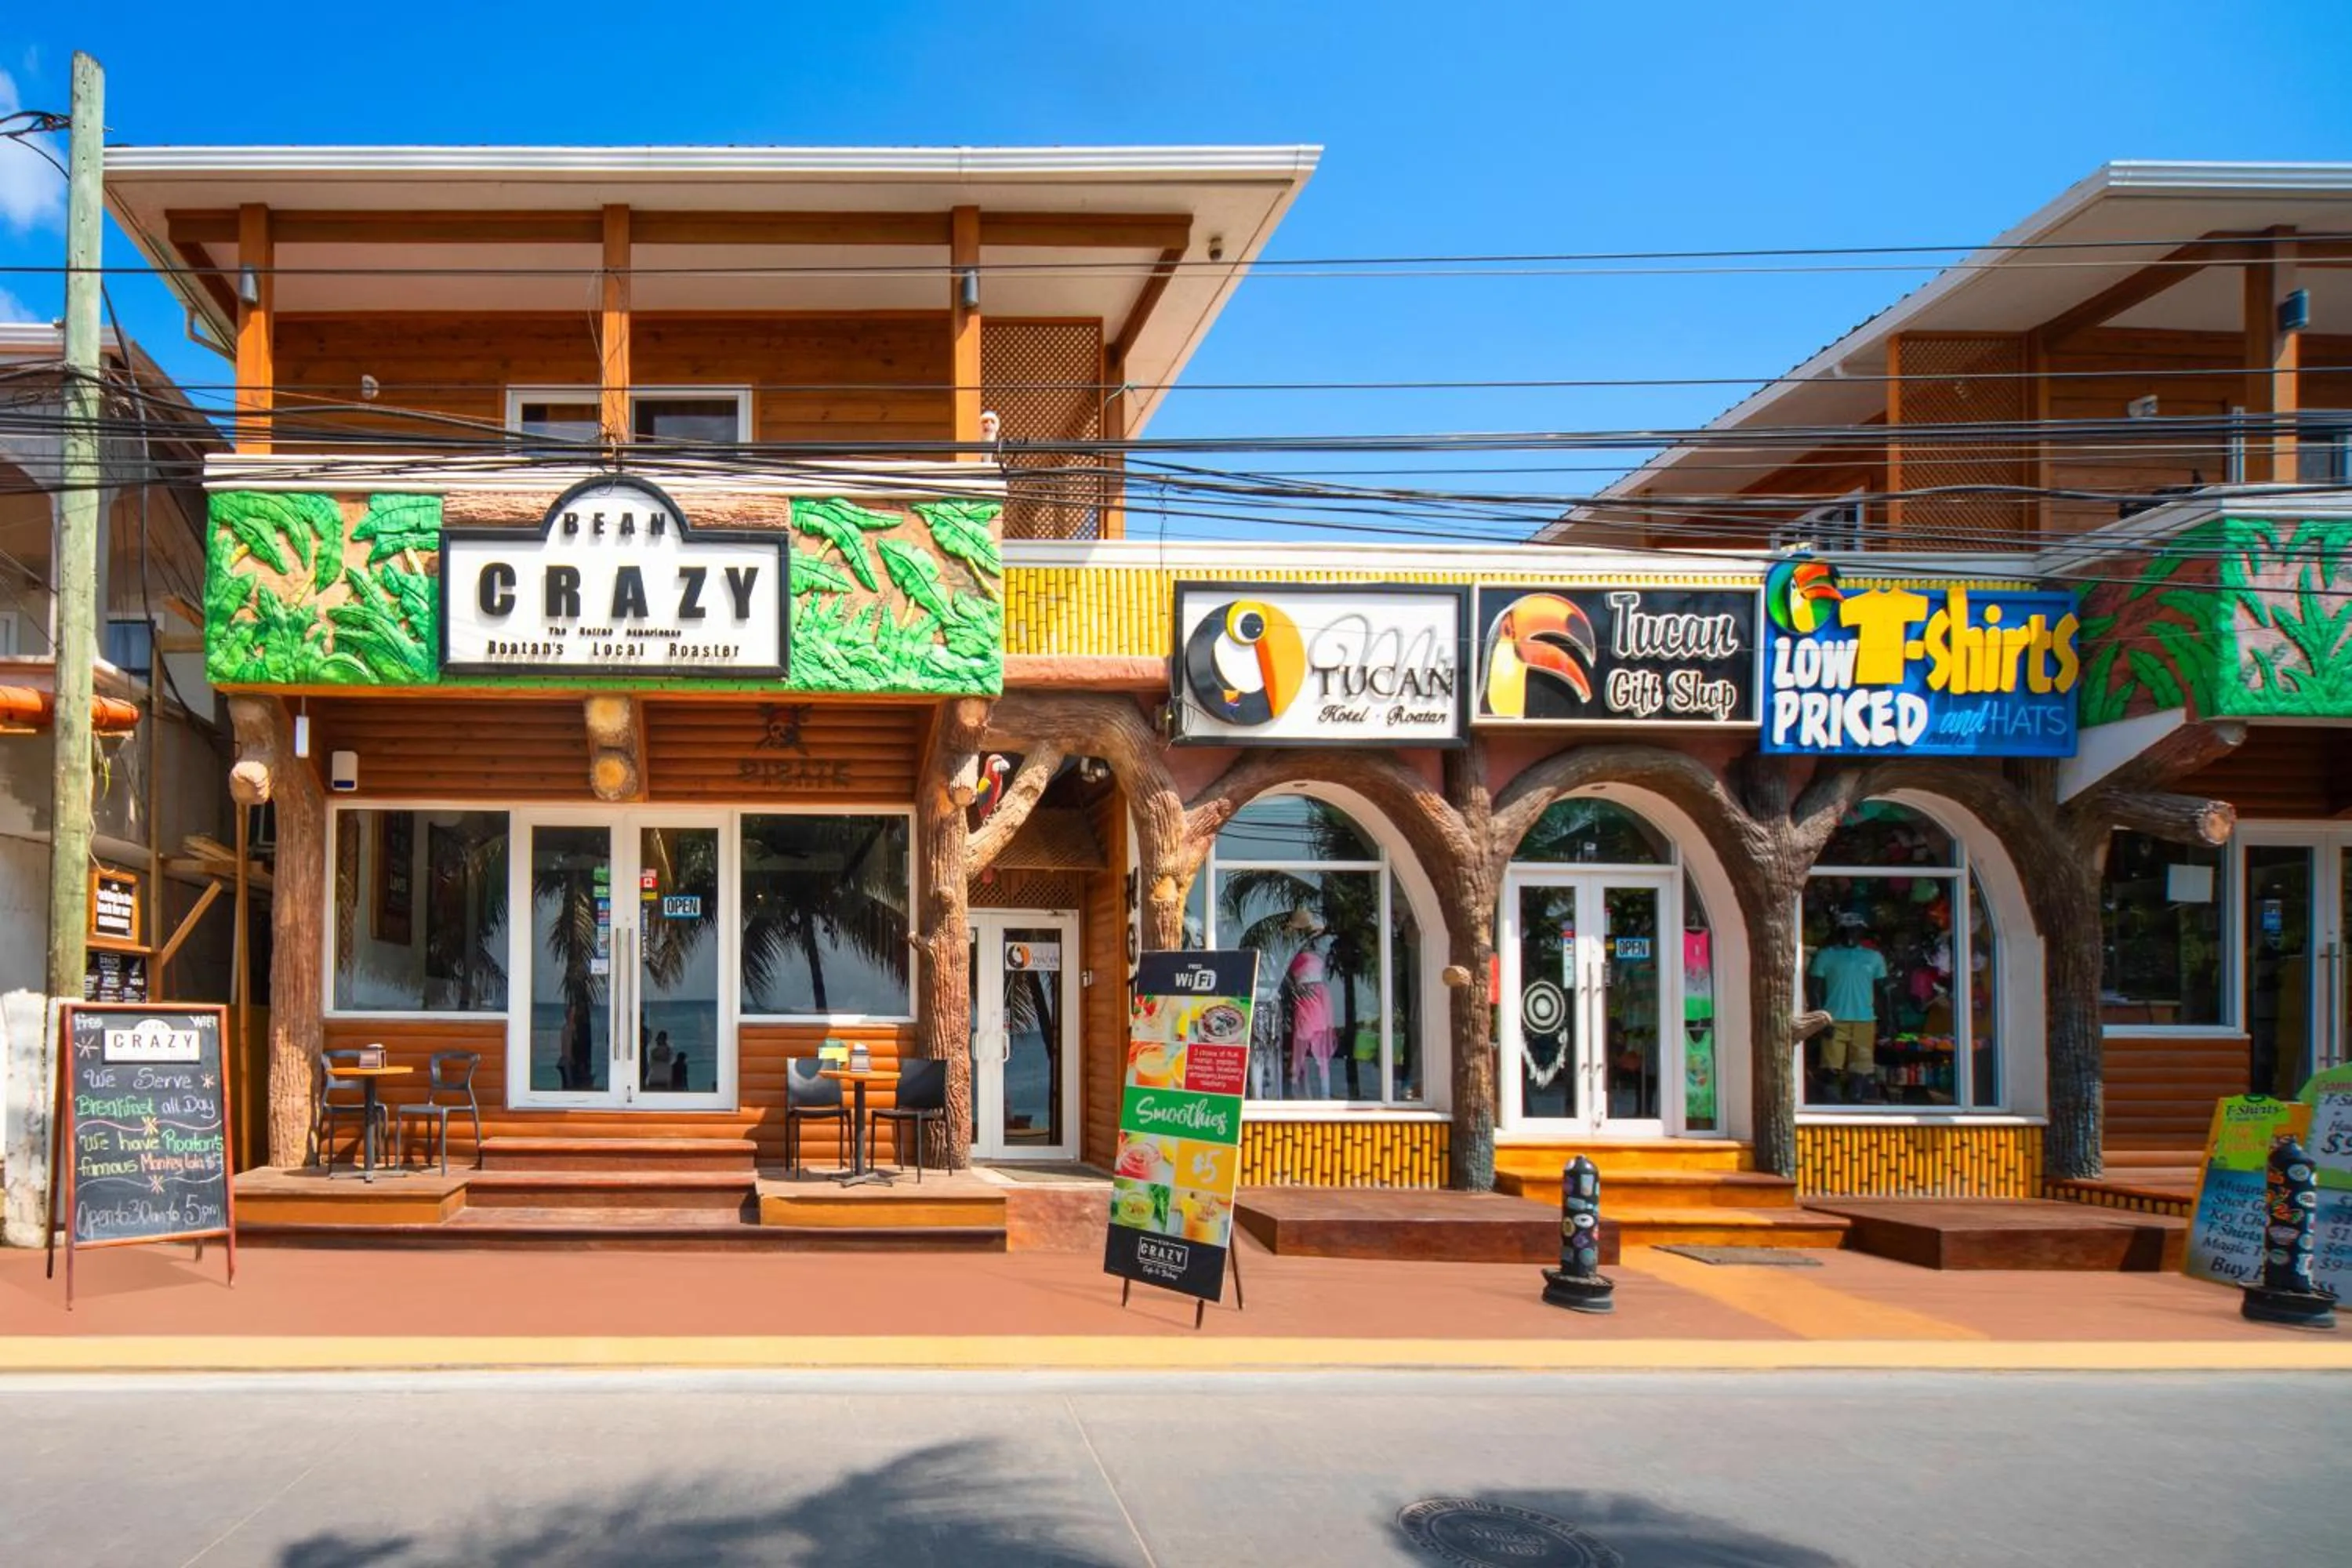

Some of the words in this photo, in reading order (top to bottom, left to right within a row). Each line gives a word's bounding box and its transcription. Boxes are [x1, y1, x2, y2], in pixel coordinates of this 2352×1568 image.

[564, 512, 666, 535] BEAN
[479, 562, 759, 619] CRAZY
[1607, 591, 1738, 659] Tucan
[488, 641, 564, 656] Roatan's
[593, 641, 644, 657] Local
[670, 642, 740, 658] Roaster
[1773, 637, 1859, 690] LOW
[1312, 665, 1454, 698] TUCAN
[1607, 669, 1662, 717] Gift
[1669, 670, 1737, 720] Shop
[1318, 705, 1369, 723] Hotel
[1386, 705, 1447, 726] Roatan
[1773, 689, 1928, 748] PRICED
[1940, 701, 1988, 734] and
[1990, 702, 2067, 735] HATS
[667, 898, 697, 913] OPEN
[1619, 940, 1646, 956] OPEN
[114, 1034, 193, 1048] CRAZY
[82, 1069, 117, 1088] We
[132, 1067, 193, 1090] Serve
[75, 1094, 158, 1118] Breakfast
[162, 1097, 180, 1114] all
[182, 1094, 216, 1119] Day
[1136, 1097, 1228, 1135] Smoothies
[79, 1132, 111, 1152] We
[118, 1131, 161, 1152] have
[77, 1156, 139, 1178] famous
[1192, 1149, 1222, 1183] $5
[1142, 1243, 1183, 1262] CRAZY
[2209, 1256, 2250, 1279] Buy
